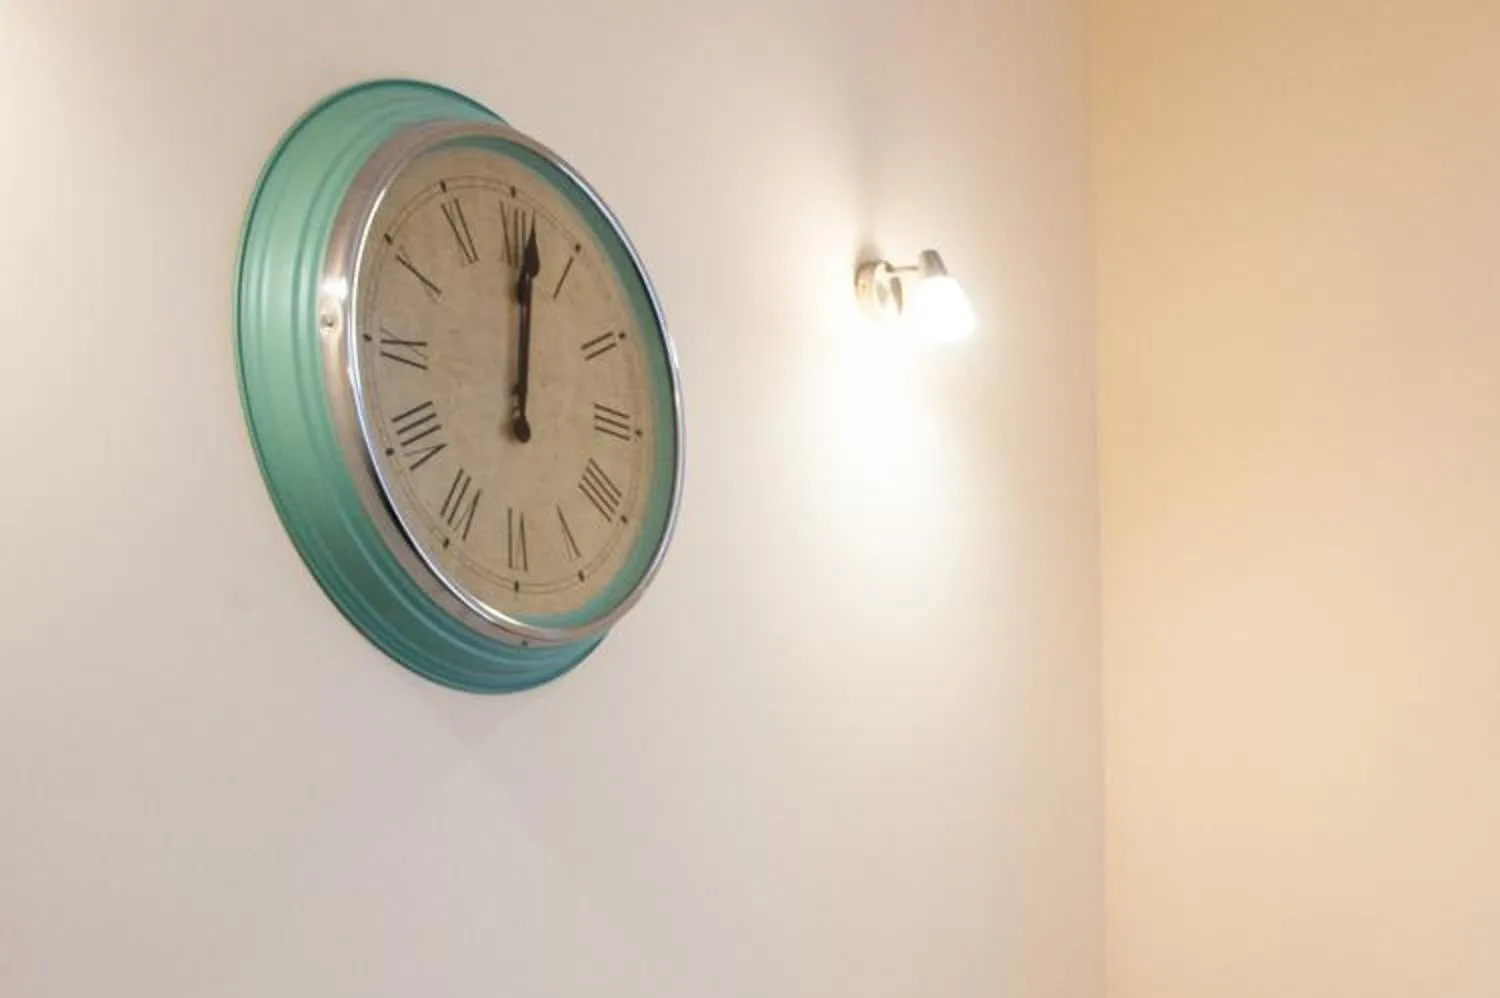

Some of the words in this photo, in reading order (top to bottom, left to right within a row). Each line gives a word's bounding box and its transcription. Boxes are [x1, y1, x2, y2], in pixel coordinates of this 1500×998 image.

[440, 198, 479, 266] XI
[395, 246, 442, 302] X
[552, 256, 574, 300] I
[380, 328, 429, 371] IX
[580, 331, 617, 361] II
[391, 400, 449, 471] VIII
[593, 403, 631, 442] III
[440, 467, 482, 542] VII
[577, 457, 623, 523] IIII
[507, 506, 529, 573] VI
[556, 504, 582, 562] V
